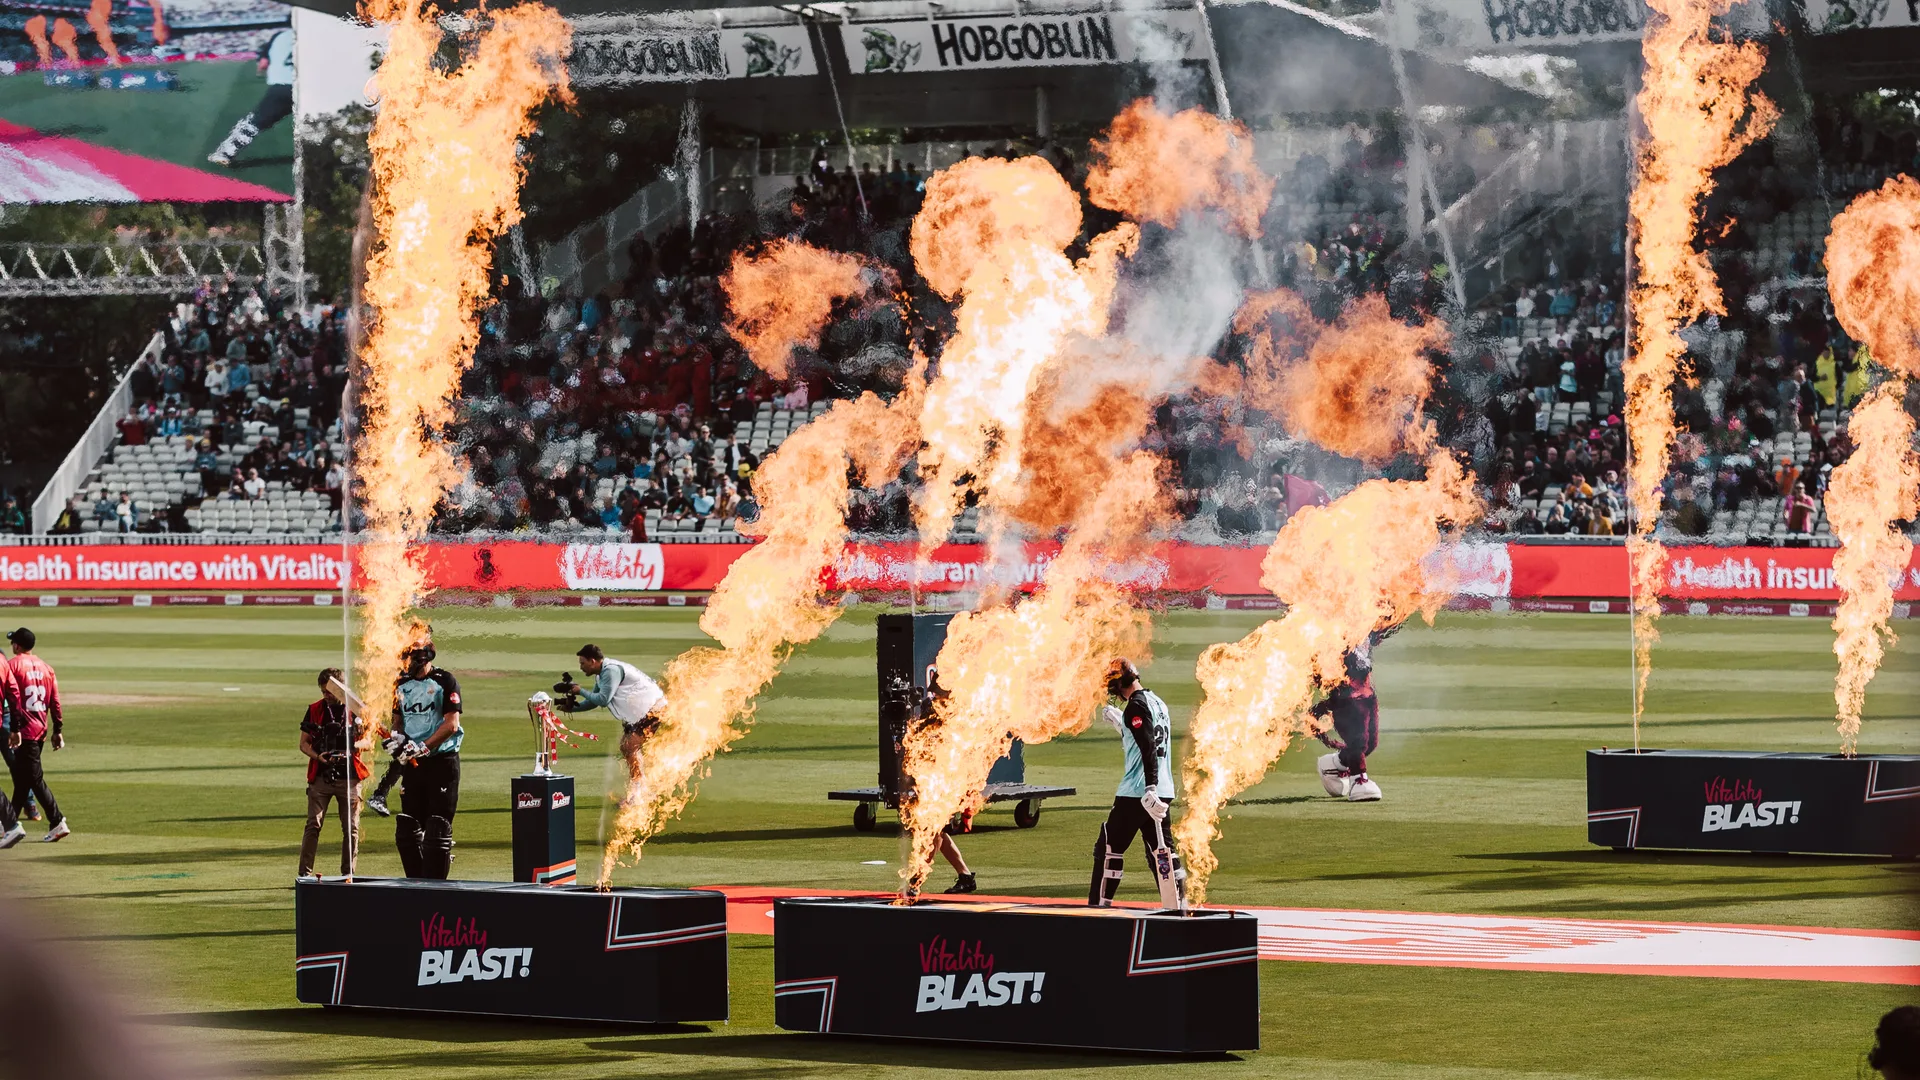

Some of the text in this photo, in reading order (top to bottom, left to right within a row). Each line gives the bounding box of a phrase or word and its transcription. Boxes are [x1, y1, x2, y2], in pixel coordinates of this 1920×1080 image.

[932, 16, 1117, 66] HOBGOBLIN
[76, 554, 197, 581] insurance
[201, 554, 257, 581] with
[260, 553, 351, 587] Vitality
[1670, 557, 1761, 589] Health
[1704, 775, 1762, 808] Vitality
[1702, 801, 1802, 832] BLAST!
[420, 911, 487, 956] Vitality
[417, 947, 534, 986] BLAST!
[919, 934, 994, 981] Vitality
[915, 972, 1046, 1013] BLAST!
